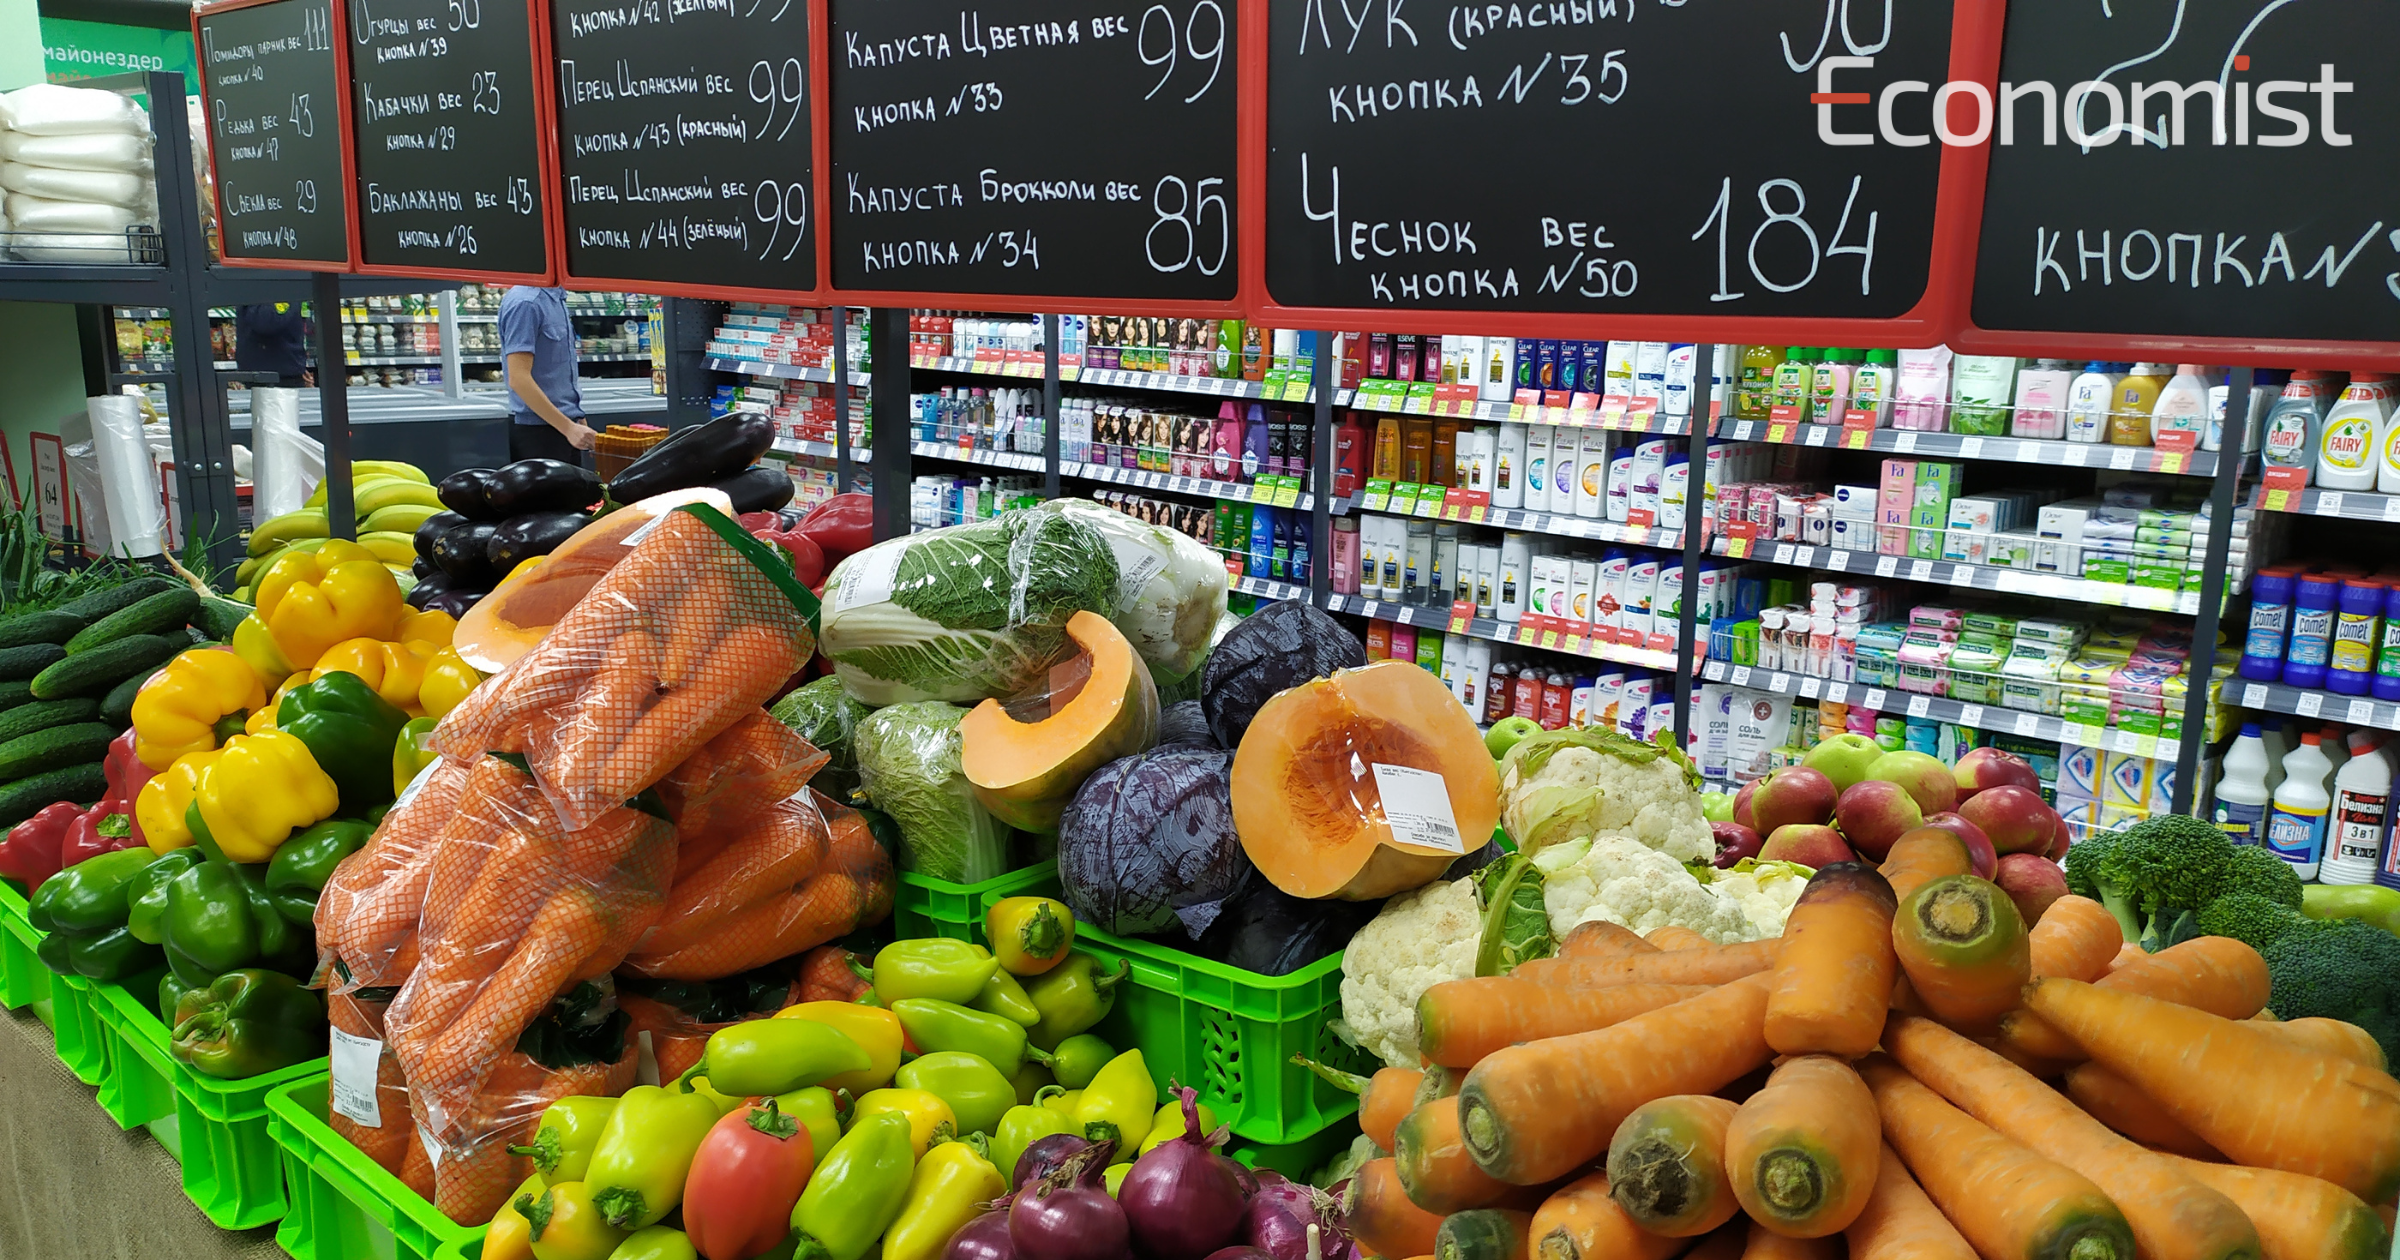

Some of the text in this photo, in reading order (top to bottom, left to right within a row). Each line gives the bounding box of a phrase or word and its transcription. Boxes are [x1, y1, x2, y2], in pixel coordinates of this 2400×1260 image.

[287, 36, 301, 50] ВЕС
[304, 6, 330, 51] 111
[416, 17, 437, 31] ВЕС
[571, 6, 626, 38] КНОПКА
[376, 42, 416, 64] КНОПКА
[846, 31, 952, 69] КАПУСТА
[1091, 15, 1130, 39] ВЕС
[1137, 1, 1226, 104] 99
[363, 70, 500, 124] КАБАЧКИ ВЕС 23
[705, 73, 733, 95] ВЕС
[749, 57, 803, 138] 99
[1328, 74, 1484, 123] КНОПКА
[261, 115, 279, 130] ВЕС
[289, 92, 314, 138] 43
[855, 96, 936, 133] КНОПКА
[386, 133, 425, 152] КНОПКА
[574, 131, 629, 158] КНОПКА
[267, 198, 283, 211] ВЕС
[295, 179, 317, 214] 29
[368, 175, 533, 215] БАКЛАЖАНЫ ВЕС 43
[721, 182, 748, 199] ВЕС
[754, 180, 806, 262] 99
[847, 168, 1228, 276] КАПУСТА БРОККОЛИ ВЕС 85
[1301, 152, 1878, 301] ЧЕСНОК ВЕС 184
[398, 230, 441, 249] КНОПКА
[579, 226, 631, 249] КНОПКА
[863, 239, 960, 273] КНОПКА
[2033, 226, 2296, 297] КНОПКА
[1369, 268, 1519, 302] КНОПКА
[2079, 386, 2092, 399] Fa
[2126, 389, 2139, 403] Fa
[2269, 430, 2299, 446] FAIRY
[2330, 436, 2362, 453] FAIRY
[1891, 463, 1905, 477] Fa
[1927, 464, 1940, 477] Fa
[45, 482, 57, 505] 64
[1887, 510, 1900, 523] Fa
[1921, 512, 1934, 524] Fa
[2254, 611, 2281, 627] comet
[2300, 618, 2327, 634] comet
[2339, 622, 2367, 639] comet
[1739, 725, 1761, 734] СОЛЬ
[2341, 794, 2384, 813] Белизна
[2351, 826, 2374, 839] 3 в 1
